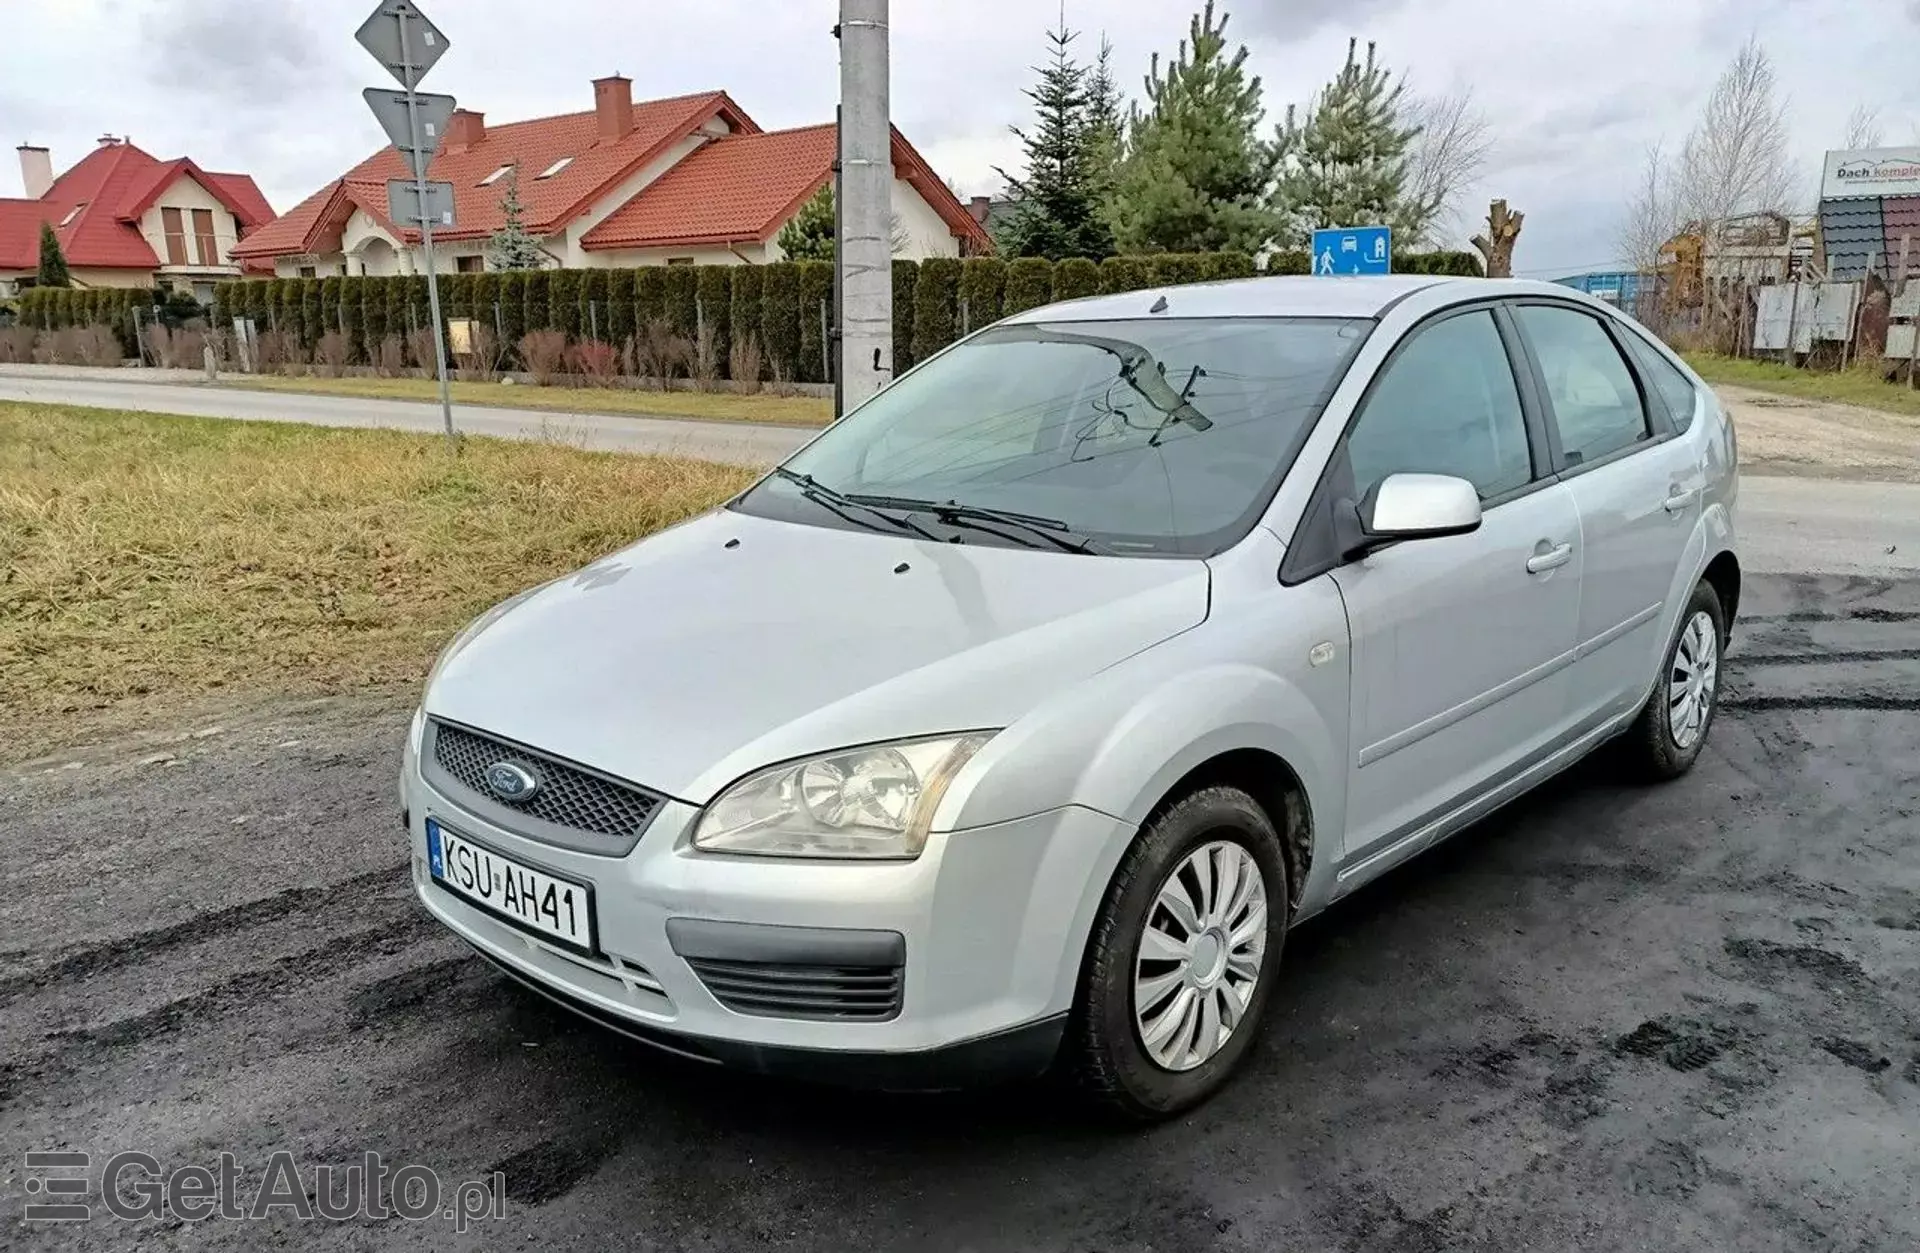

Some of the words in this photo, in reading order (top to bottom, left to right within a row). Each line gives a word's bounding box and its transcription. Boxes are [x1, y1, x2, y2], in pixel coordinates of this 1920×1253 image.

[1837, 168, 1869, 177] Dach
[492, 769, 518, 792] Ford
[443, 835, 492, 898] KSU
[504, 865, 576, 935] AH41
